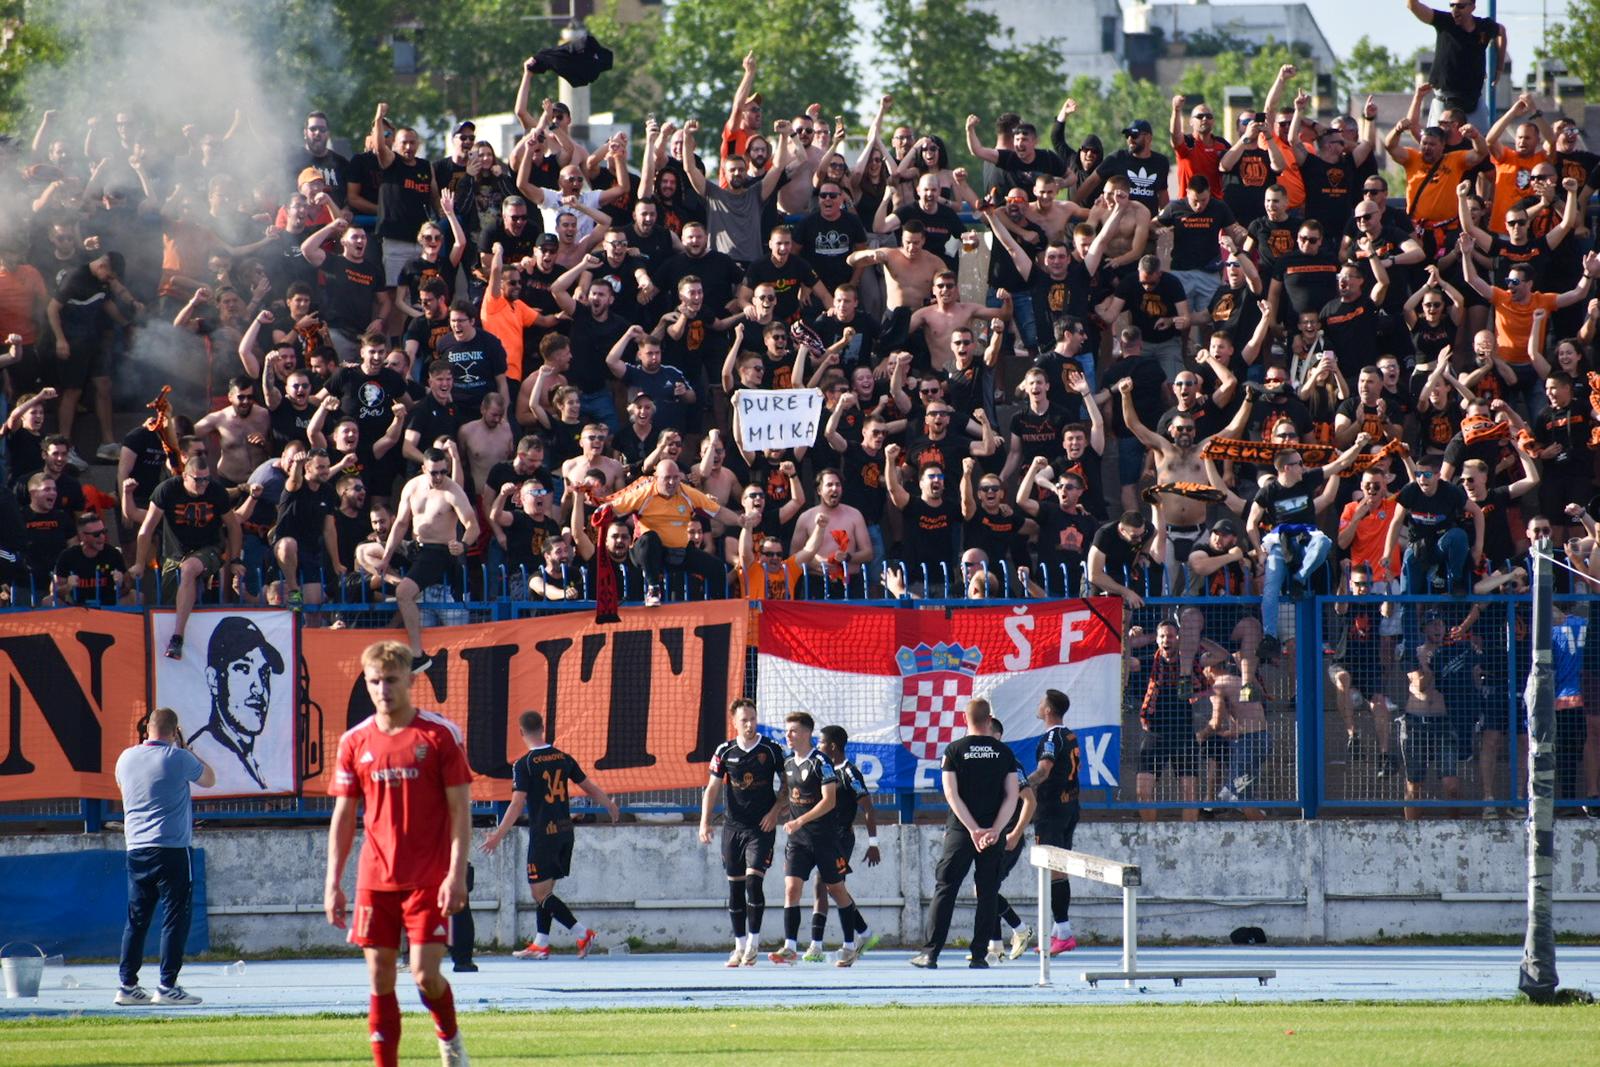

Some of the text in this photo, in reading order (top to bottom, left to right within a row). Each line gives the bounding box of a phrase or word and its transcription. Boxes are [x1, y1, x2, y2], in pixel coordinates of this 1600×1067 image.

[448, 351, 484, 363] ŠIBENIK
[743, 395, 798, 415] PURE
[749, 421, 815, 443] MLIKA
[1003, 604, 1092, 672] Š F
[963, 750, 1001, 760] SECURITY
[969, 745, 994, 753] SOKOL
[542, 769, 565, 805] 34
